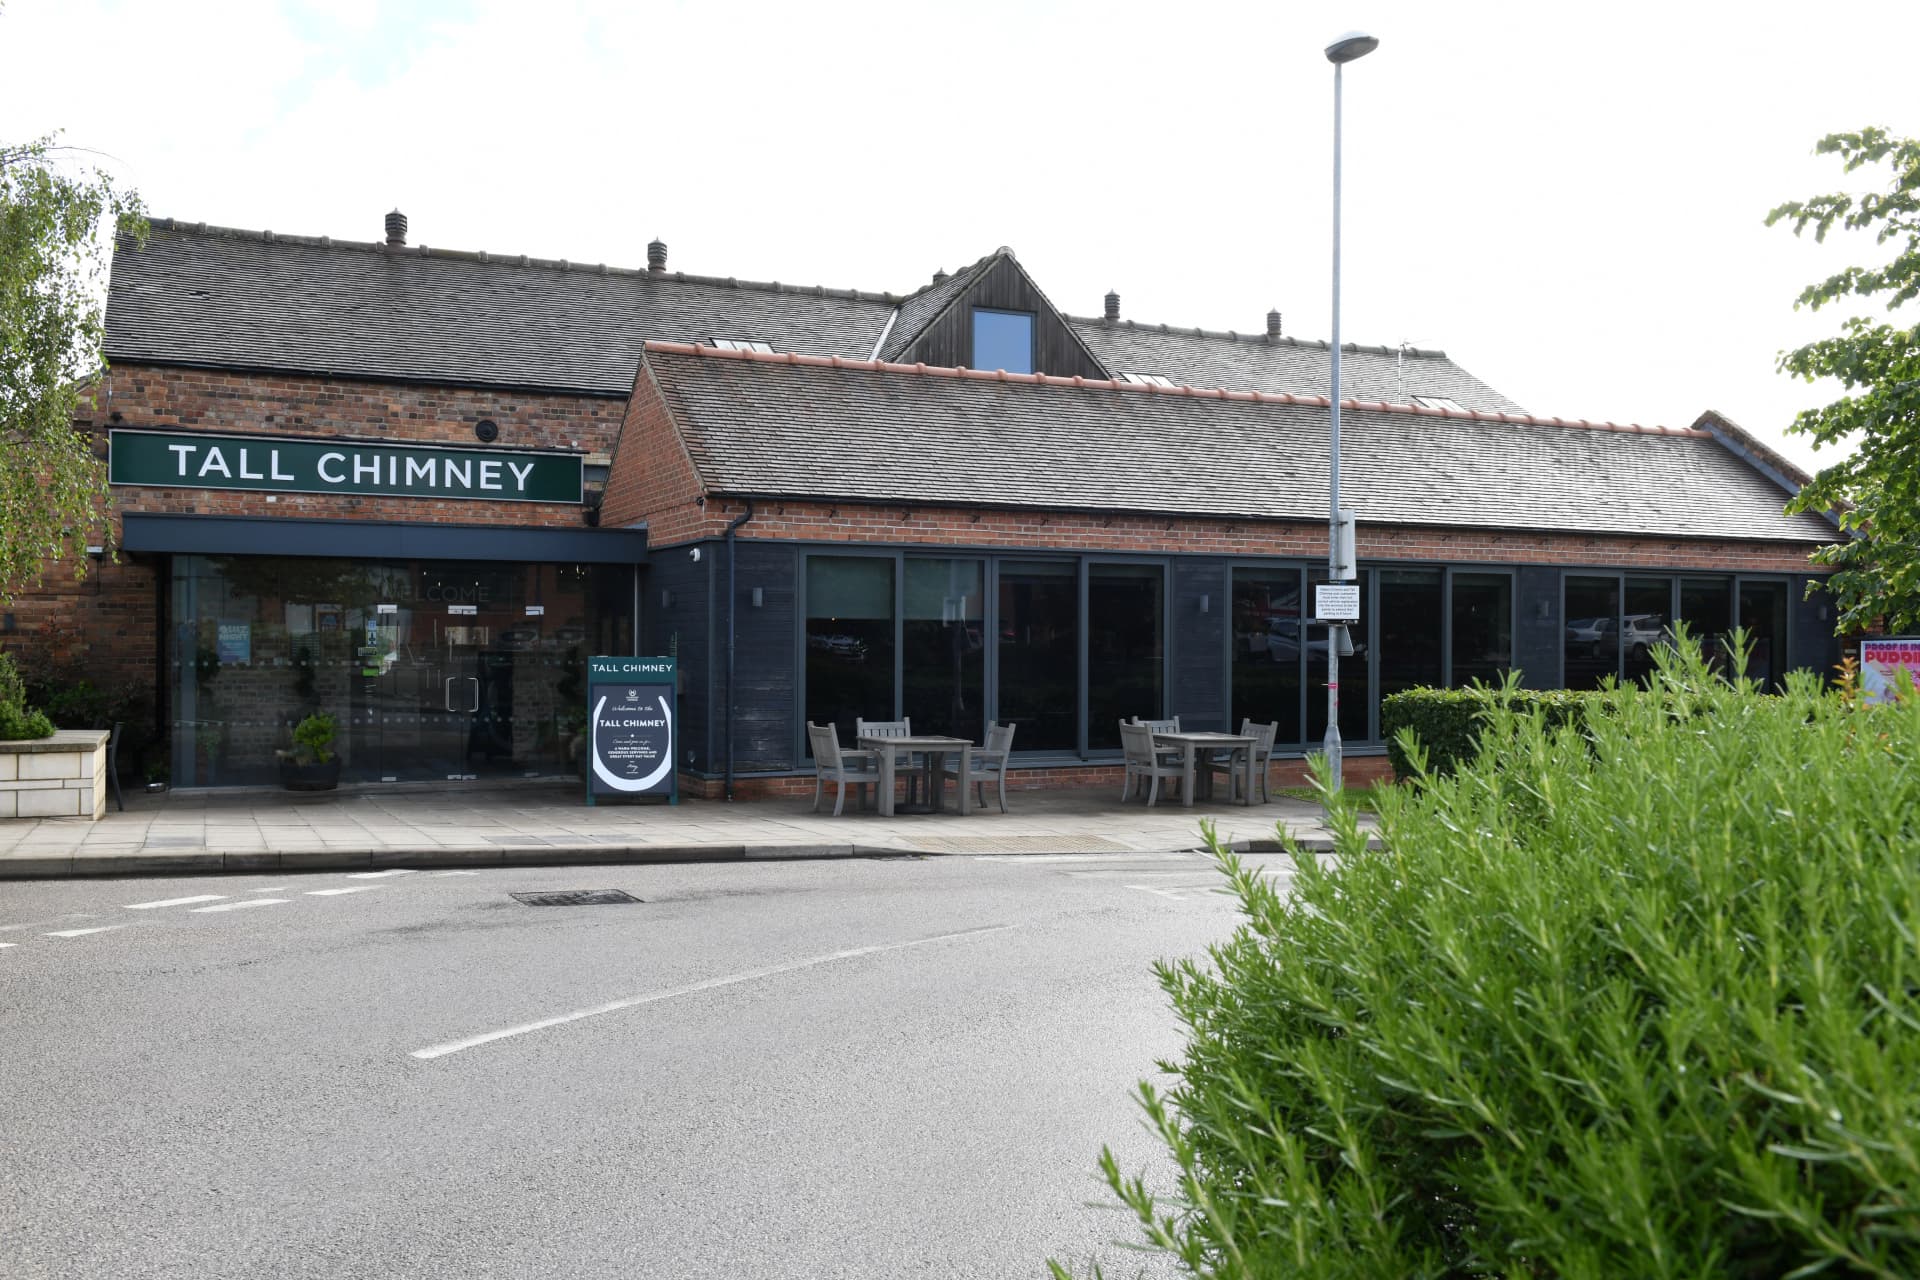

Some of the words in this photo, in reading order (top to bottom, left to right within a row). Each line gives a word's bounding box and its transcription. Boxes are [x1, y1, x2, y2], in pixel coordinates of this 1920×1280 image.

[168, 444, 295, 481] TALL
[317, 453, 534, 491] CHIMNEY
[592, 664, 619, 672] TALL
[623, 664, 672, 672] CHIMNEY
[600, 719, 621, 727] TALL
[623, 719, 666, 727] CHIMNEY
